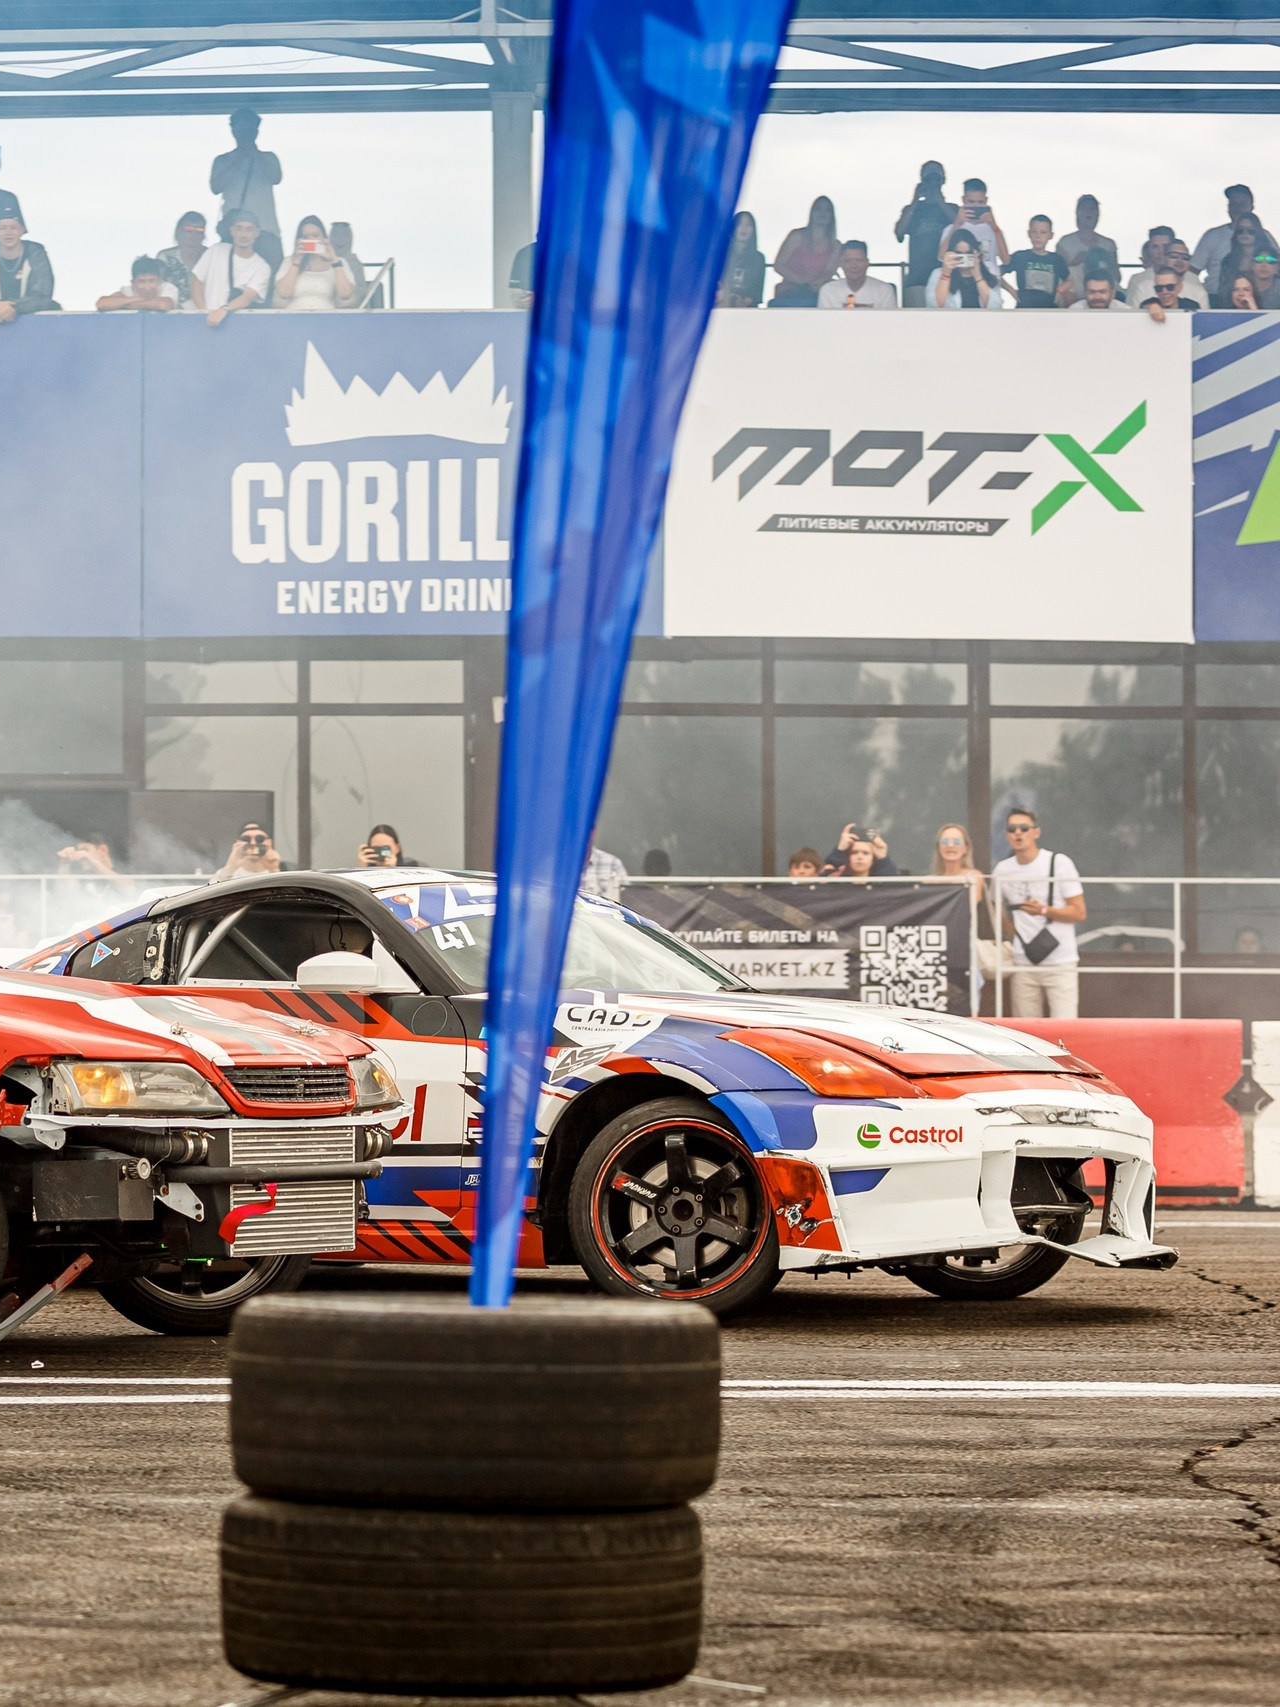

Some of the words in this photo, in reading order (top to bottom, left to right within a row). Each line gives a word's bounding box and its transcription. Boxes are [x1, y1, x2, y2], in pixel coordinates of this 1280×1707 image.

[231, 457, 511, 564] GORILL
[776, 516, 860, 531] ЛИТИЕВЫЕ
[864, 518, 990, 534] АККУМУЛЯТОРЫ
[276, 579, 413, 615] ENERGY
[431, 920, 476, 951] 47
[748, 930, 811, 943] БИЛЕТЫ
[816, 930, 839, 943] НА
[567, 1006, 652, 1028] CADS
[888, 1125, 963, 1144] Castrol
